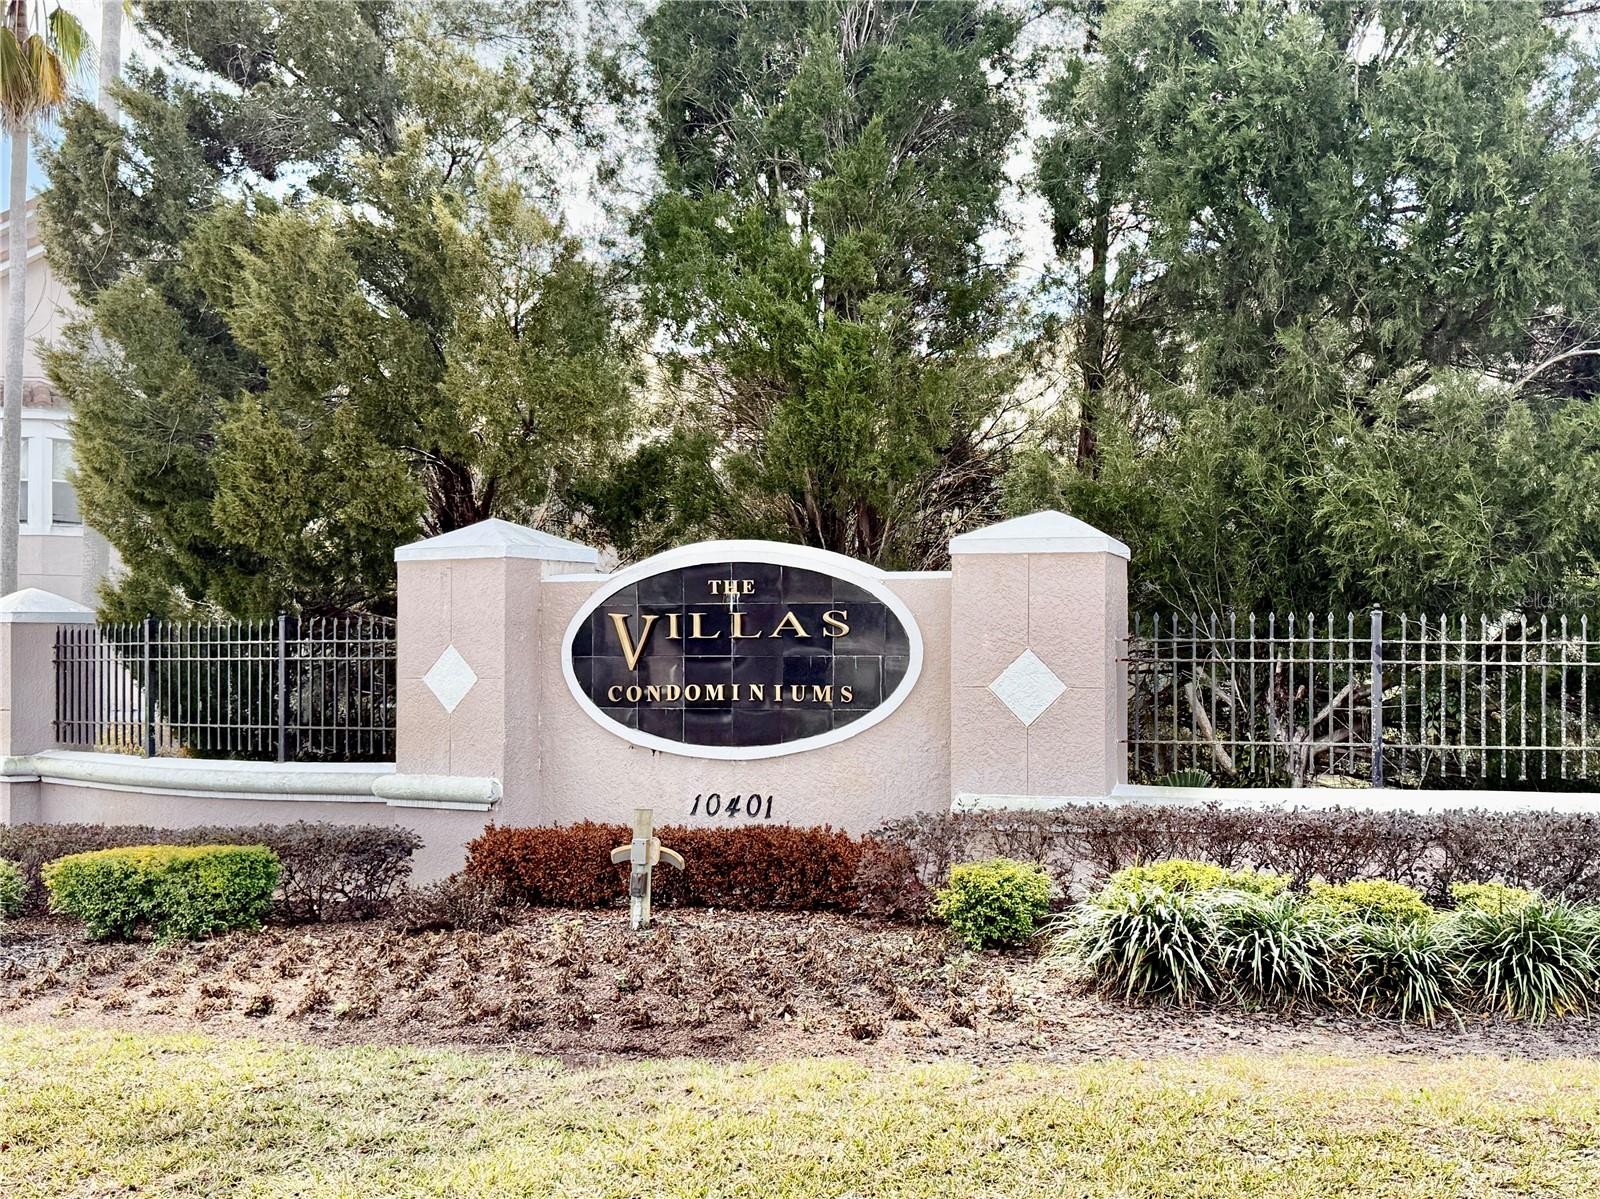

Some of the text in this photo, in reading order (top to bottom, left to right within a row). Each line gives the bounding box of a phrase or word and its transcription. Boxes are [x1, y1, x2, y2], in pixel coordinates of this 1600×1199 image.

[708, 579, 756, 595] THE
[607, 610, 851, 671] VILLAS
[607, 683, 854, 703] CONDOMINIUMS
[690, 793, 773, 819] 10401
